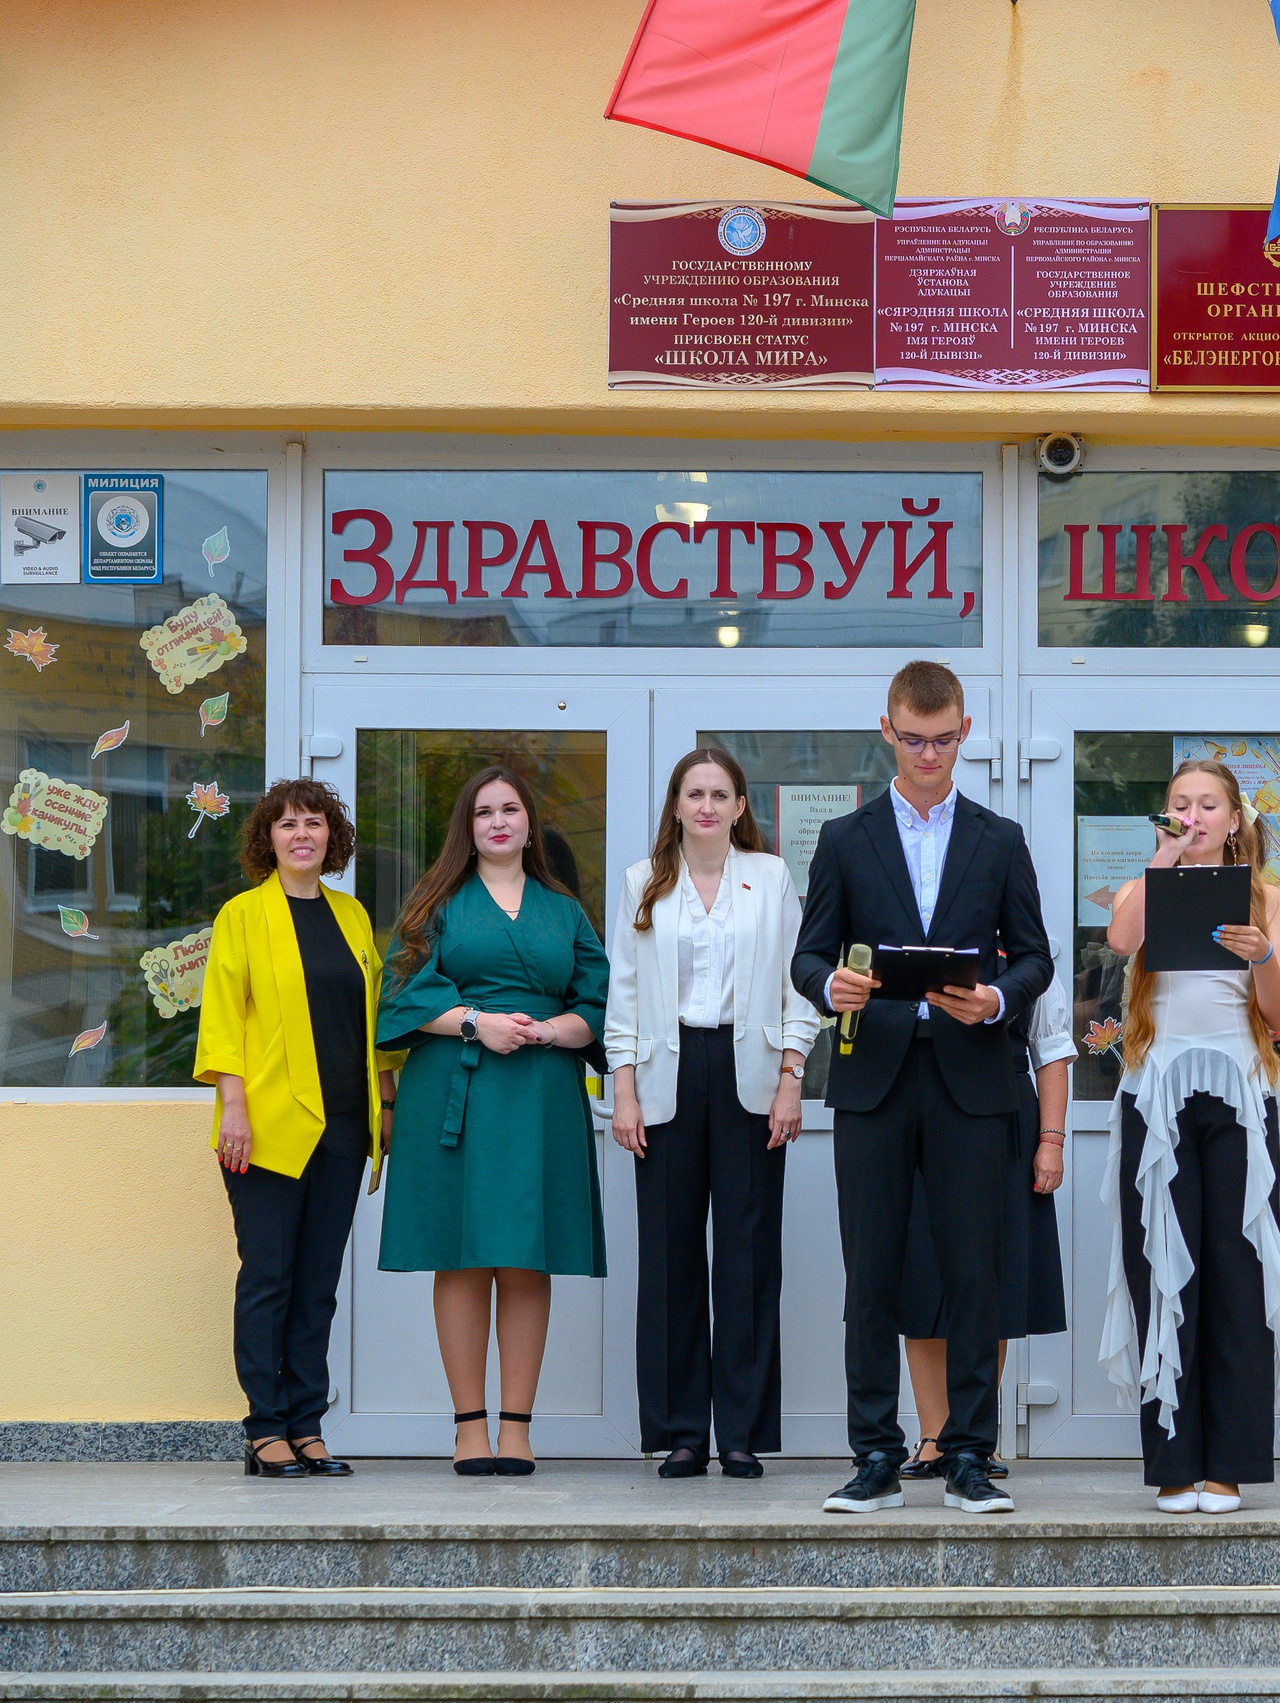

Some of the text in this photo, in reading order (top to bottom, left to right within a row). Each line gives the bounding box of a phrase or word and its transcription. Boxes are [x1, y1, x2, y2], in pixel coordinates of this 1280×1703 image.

[671, 260, 812, 272] ГОСУДАРСТВЕННОМУ
[909, 267, 977, 277] ДЗЯРЖАЎНАЯ
[1036, 271, 1131, 279] ГОСУДАРСТВЕННОЕ
[643, 275, 840, 286] УЧРЕЖДЕНИЮ ОБРАЗОВАНИЯ
[1049, 281, 1116, 289] УЧРЕЖДЕНИЕ
[918, 289, 970, 297] АДУКАЦЫІ
[1048, 290, 1118, 298] ОБРАЗОВАНИЯ
[614, 293, 869, 309] «Средняя школа № 197 г. Минска
[877, 307, 1009, 318] «СЯРЭДНЯЯ ШКОЛА
[1017, 308, 1145, 319] «СРЕДНЯЯ ШКОЛА
[630, 313, 853, 328] имени Героев 120-й дивизии»
[943, 323, 998, 332] МІНСКА
[1078, 323, 1137, 333] МИНСКА
[674, 335, 809, 346] ПРИСВОЕН СТАТУС
[907, 335, 976, 345] ІМЯ ГЕРОЯЎ
[1035, 337, 1124, 345] ИМЕНИ ГЕРОЕВ
[1173, 332, 1234, 341] ОТКРЫТОЕ
[654, 350, 828, 366] «ШКОЛА МИРА»
[900, 349, 928, 360] 120-Й
[1034, 349, 1126, 361] 120-Й ДИВИЗИИ»
[88, 478, 158, 489] МИЛИЦИЯ
[166, 611, 198, 633] Буду
[46, 784, 99, 812] уже жду
[790, 794, 851, 802] ВНИМАНИЕ!
[44, 799, 92, 822] осенние
[173, 937, 211, 960] Любл
